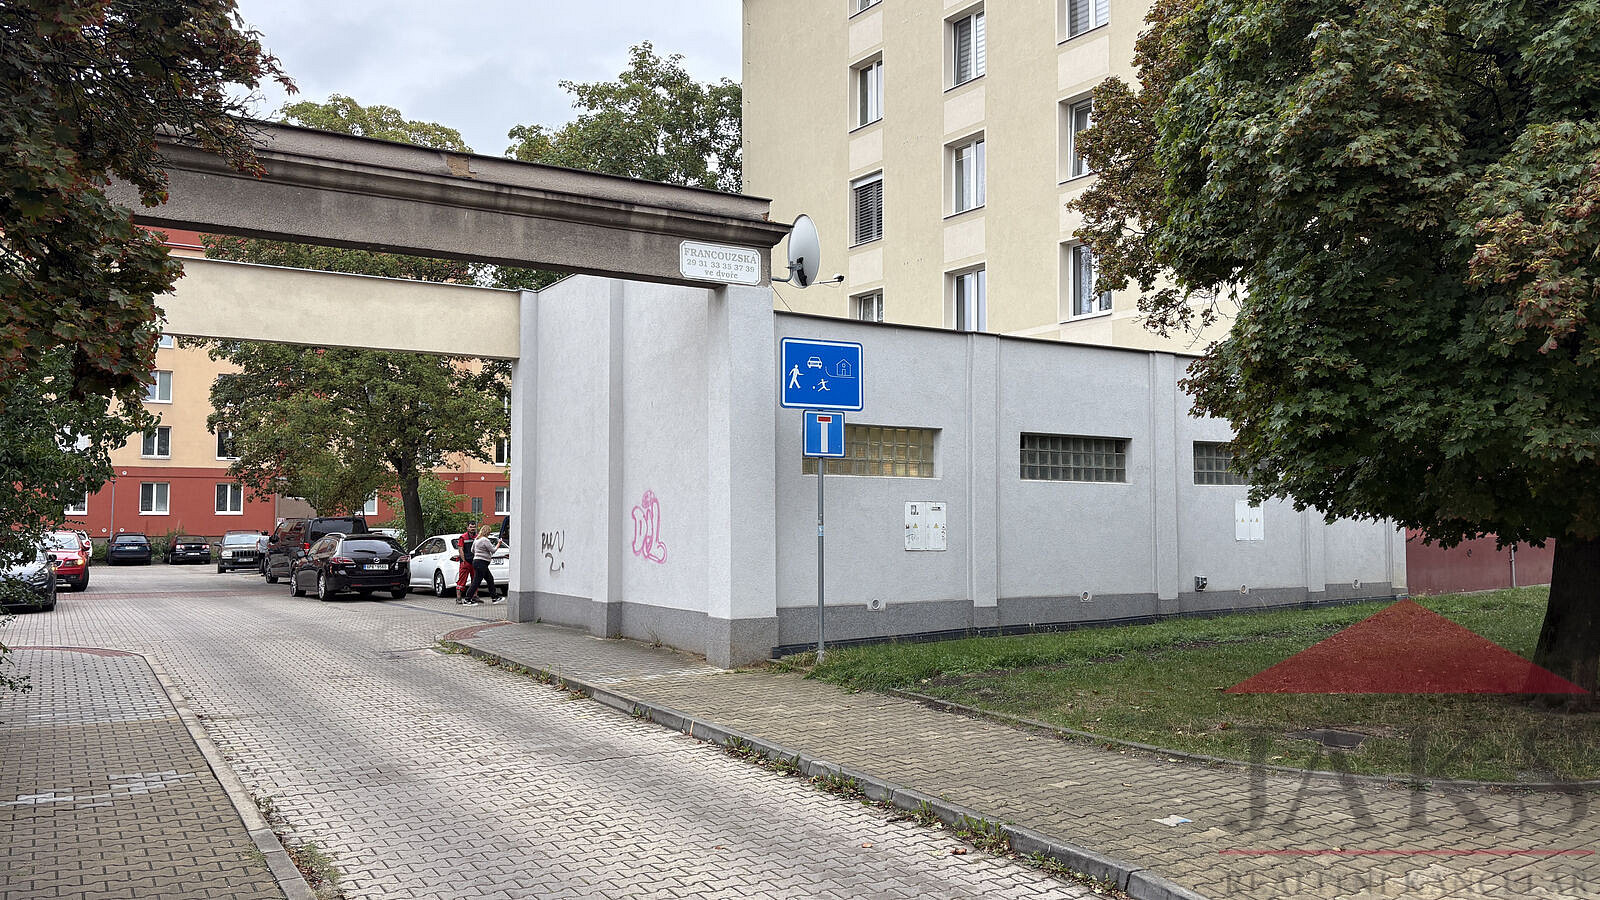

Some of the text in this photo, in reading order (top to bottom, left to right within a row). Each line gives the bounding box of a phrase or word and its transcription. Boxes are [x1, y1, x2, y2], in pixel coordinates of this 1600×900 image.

[684, 247, 757, 264] FRANCOUZSKÁ
[686, 258, 755, 273] 29 31 33 35 37 39
